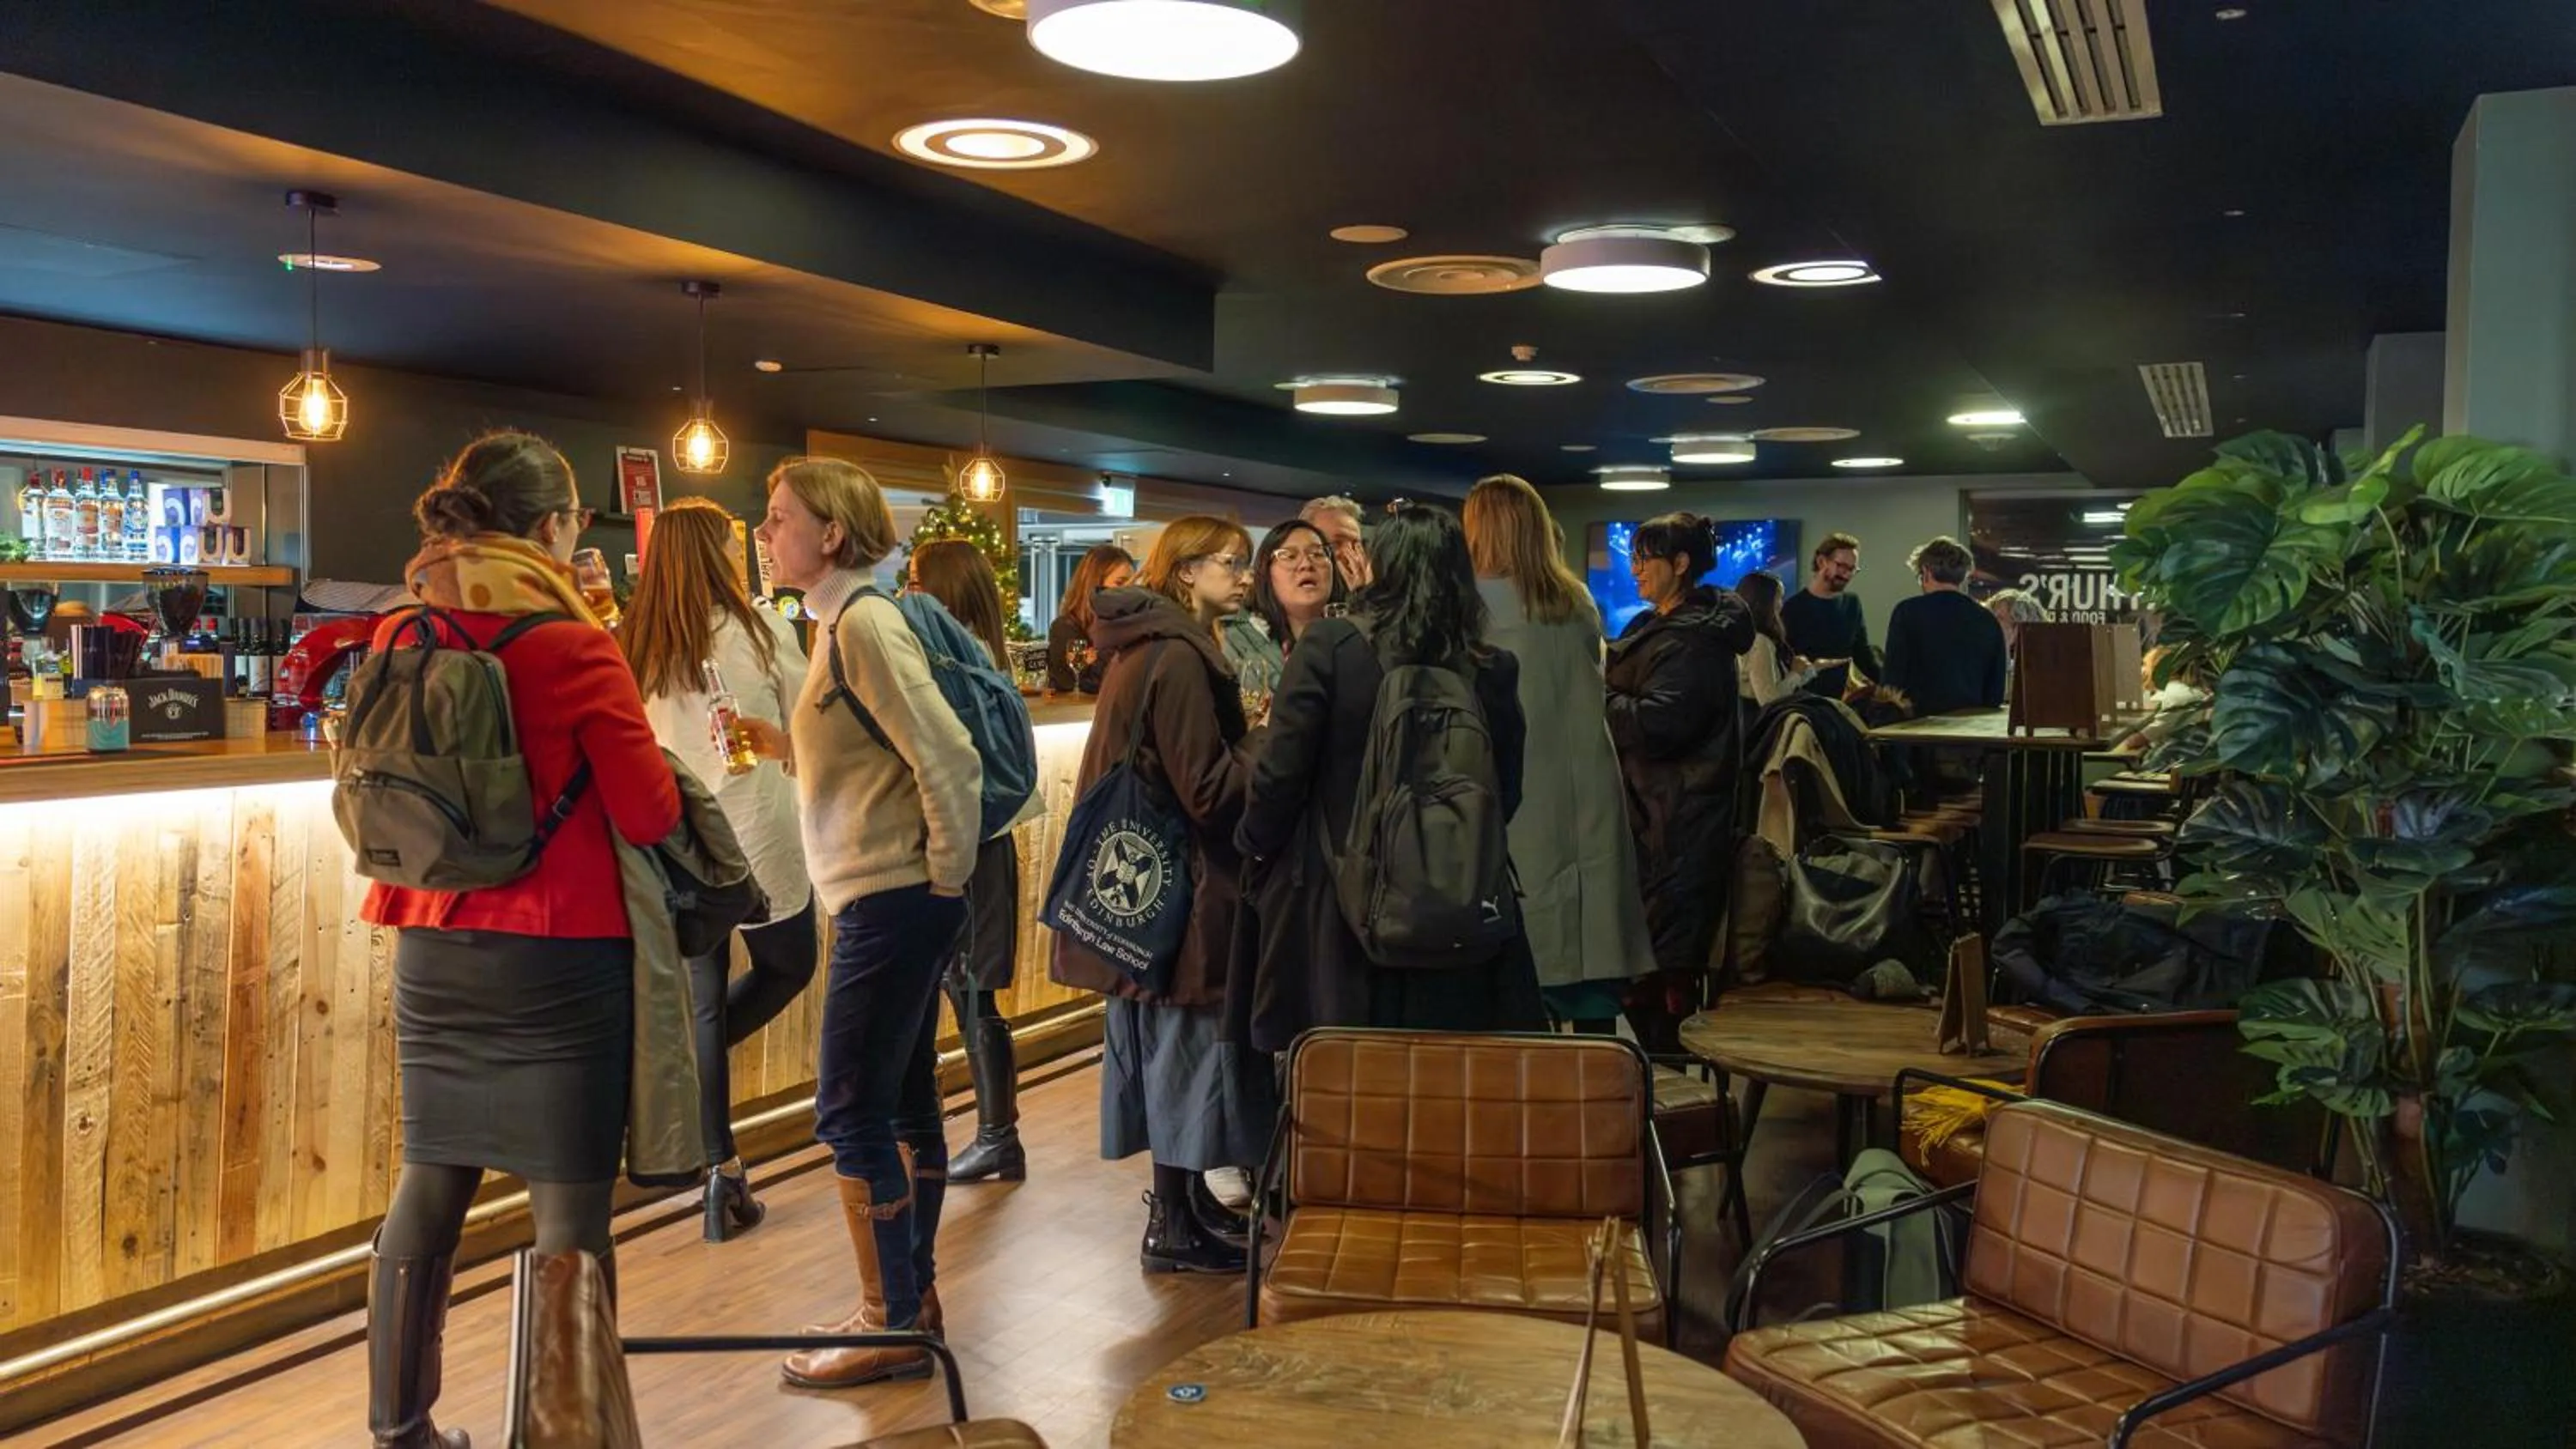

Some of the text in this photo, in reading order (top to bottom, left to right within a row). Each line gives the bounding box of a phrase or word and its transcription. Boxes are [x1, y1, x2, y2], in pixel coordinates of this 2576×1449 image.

[149, 693, 169, 710] JACK
[1058, 907, 1151, 971] Edinburgh Law School
